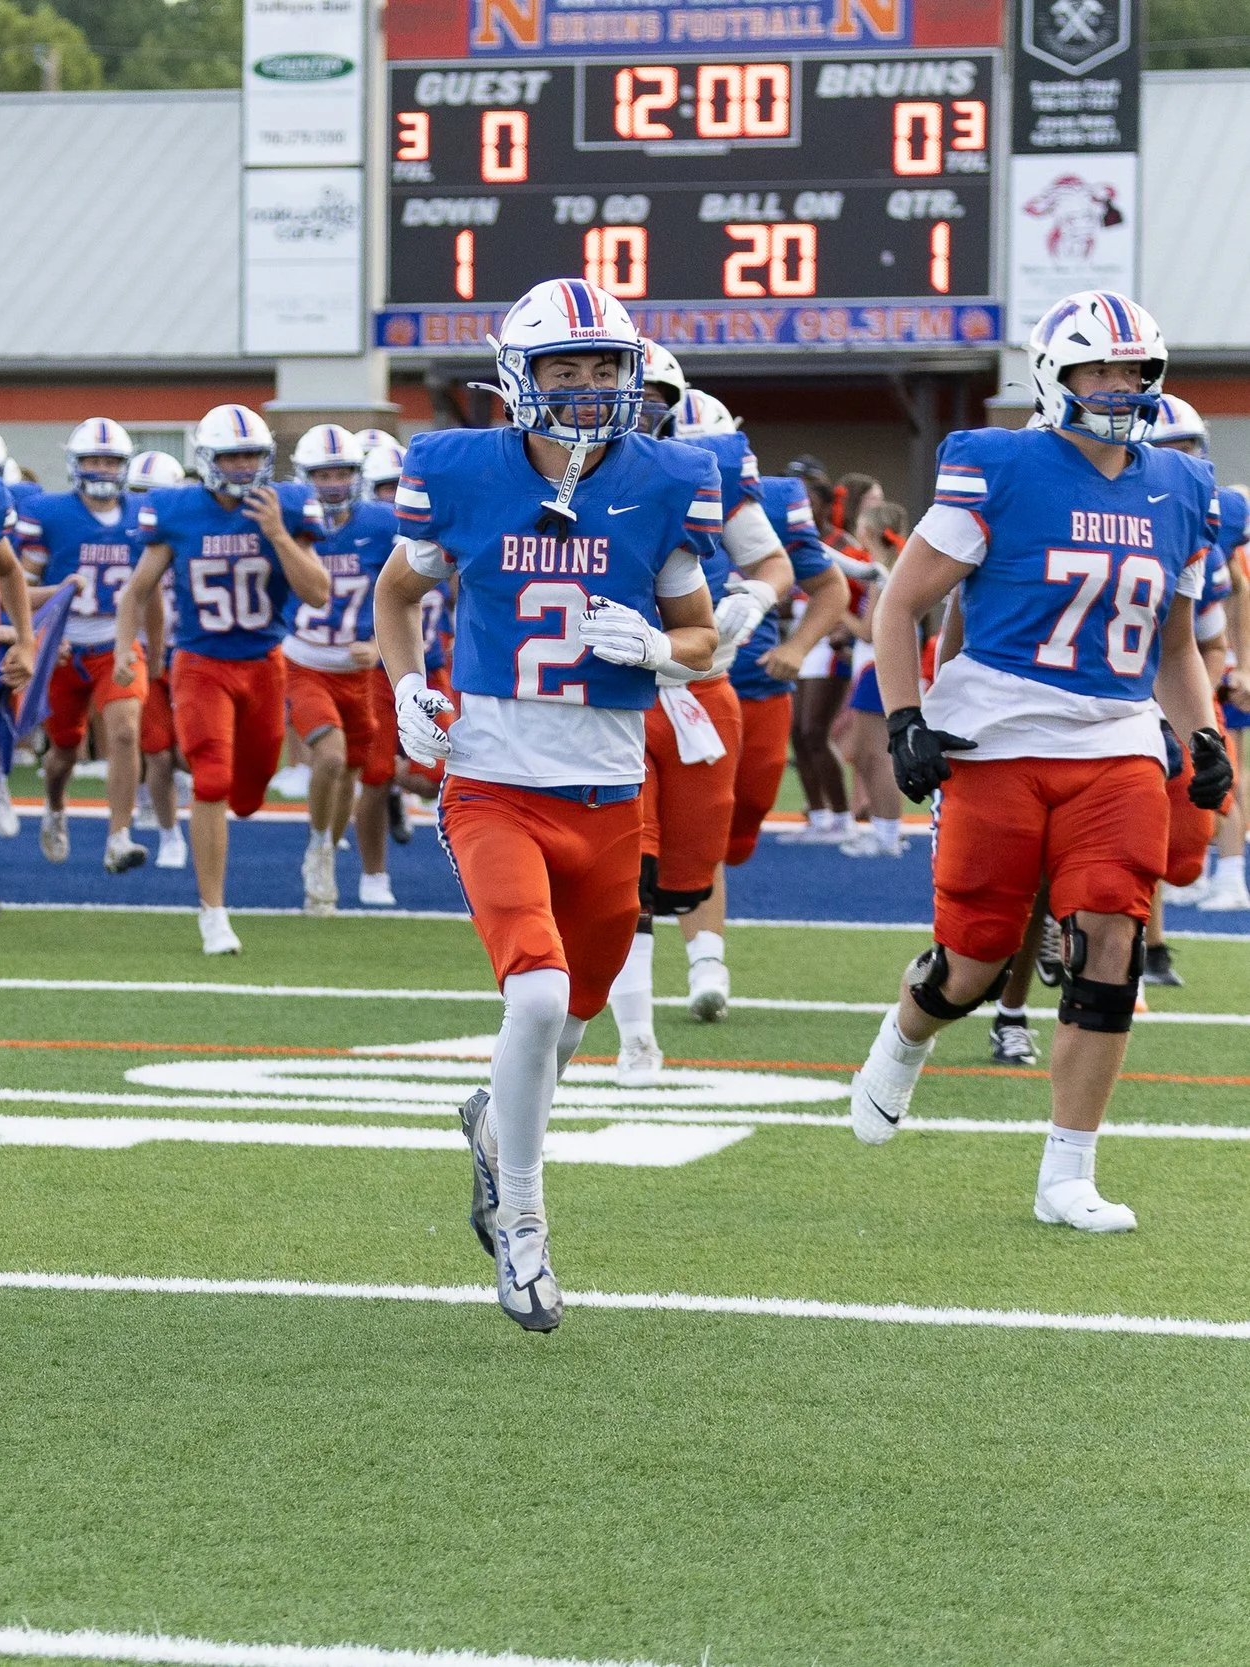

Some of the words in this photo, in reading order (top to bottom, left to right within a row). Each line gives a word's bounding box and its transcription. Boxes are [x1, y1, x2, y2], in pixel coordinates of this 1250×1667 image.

[551, 12, 661, 43] BRUINS
[668, 6, 825, 40] FOOTBALL
[415, 70, 551, 105] GUEST
[815, 60, 978, 98] BRUINS
[615, 64, 790, 139] 12:00
[396, 111, 430, 161] 3
[892, 101, 943, 175] 0
[950, 99, 987, 151] 3
[480, 110, 529, 183] 0
[401, 198, 500, 227] DOWN
[552, 195, 596, 224] TO
[602, 194, 650, 223] GO
[698, 192, 786, 222] BALL
[793, 191, 845, 220] ON
[886, 189, 967, 219] QTR.
[454, 229, 475, 300] 1
[583, 226, 648, 299] 10
[723, 223, 816, 297] 20
[929, 221, 950, 293] 1
[636, 308, 779, 340] UNTRY
[796, 306, 952, 340] 98.3FM
[1111, 346, 1146, 356] Riddell
[561, 466, 578, 500] BATTLE
[201, 533, 260, 557] BRUINS
[1071, 510, 1154, 549] BRUINS
[501, 534, 609, 575] BRUINS
[189, 556, 272, 632] 50
[1033, 547, 1166, 678] 78
[513, 578, 592, 705] 2
